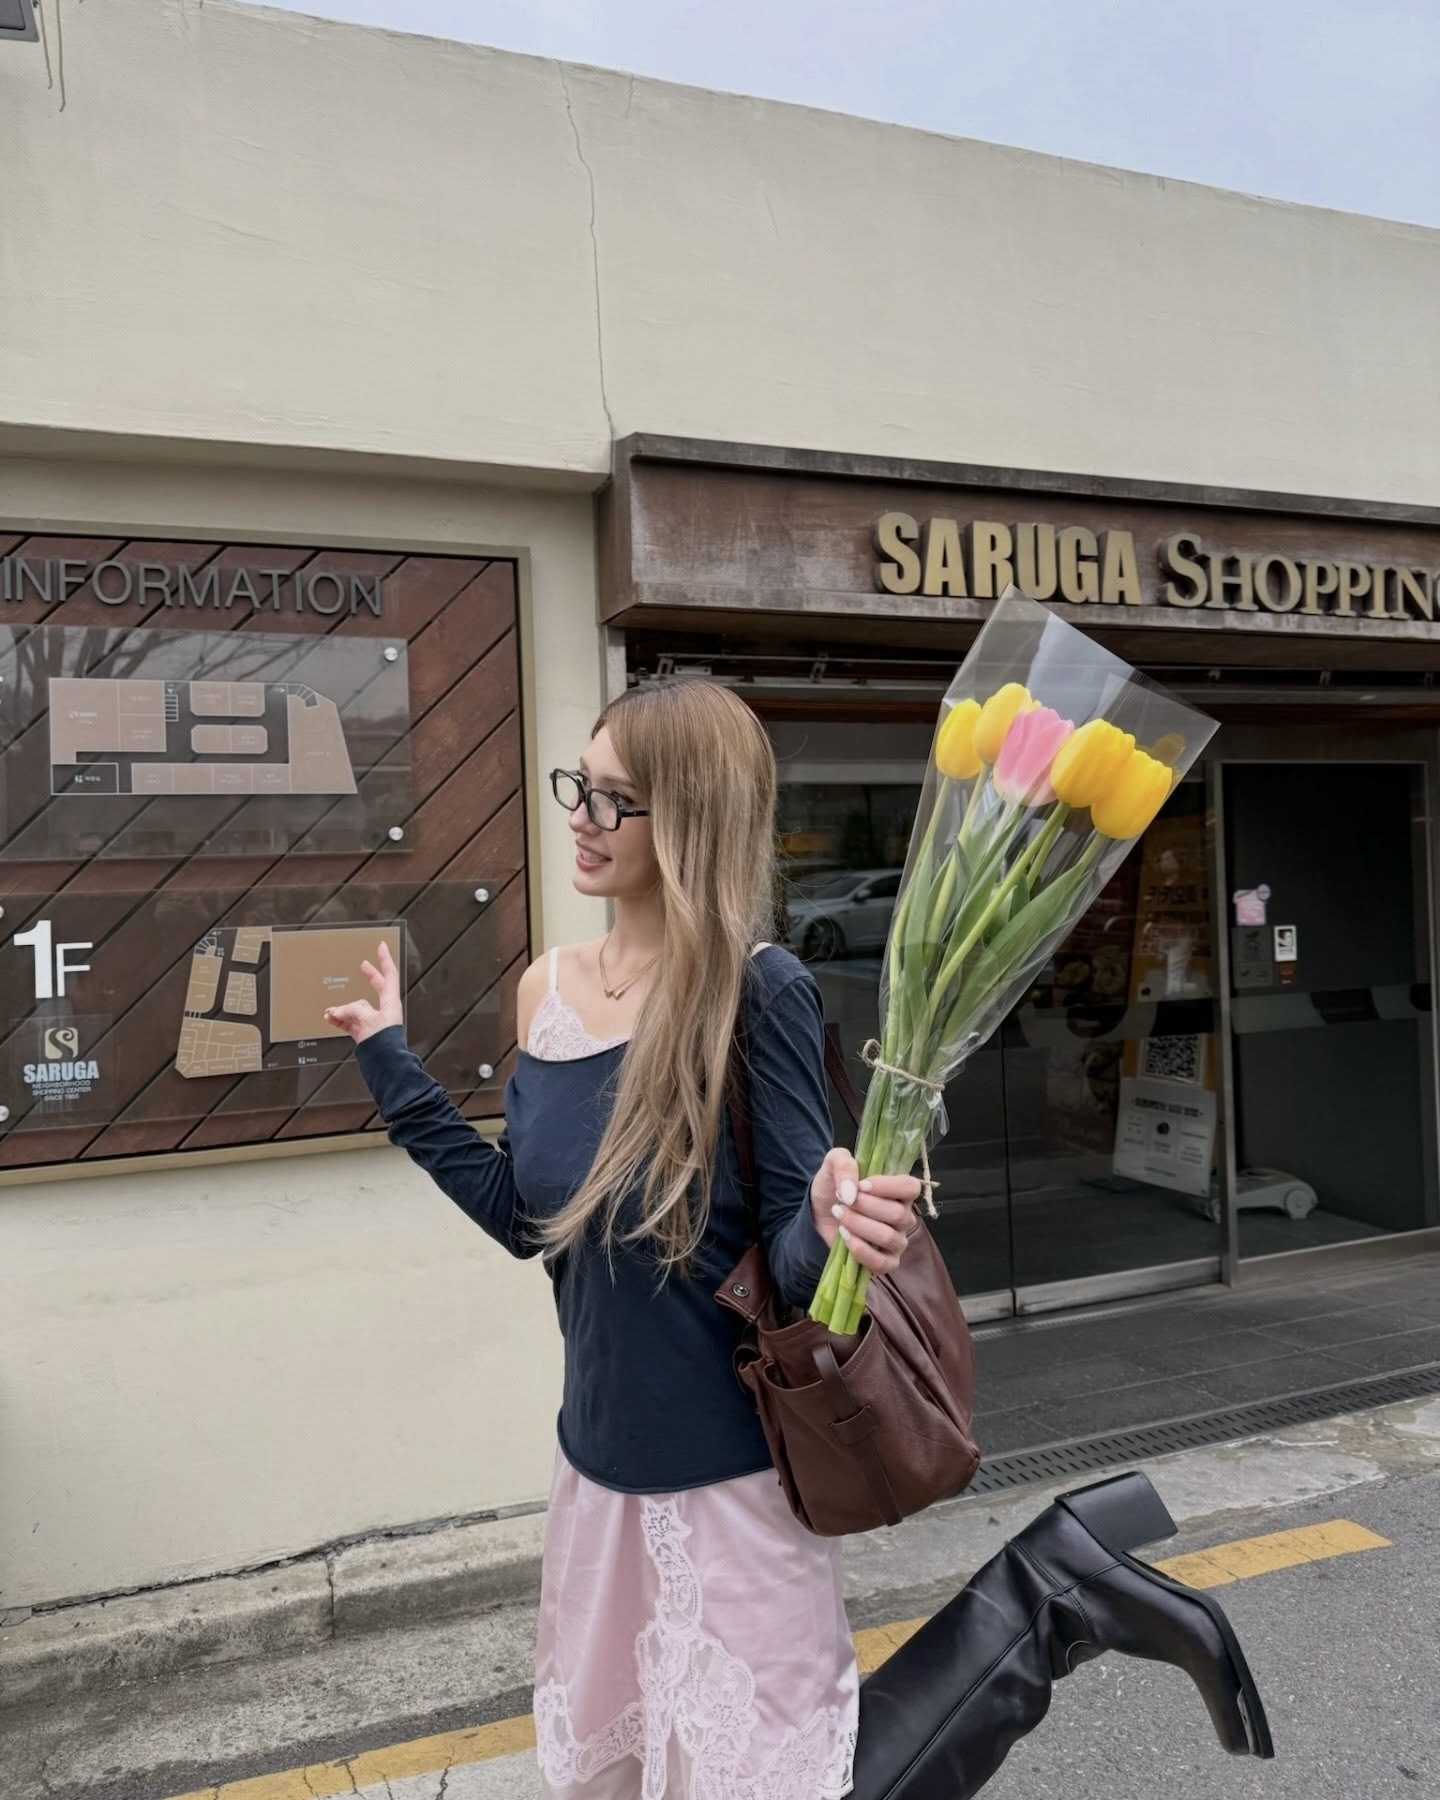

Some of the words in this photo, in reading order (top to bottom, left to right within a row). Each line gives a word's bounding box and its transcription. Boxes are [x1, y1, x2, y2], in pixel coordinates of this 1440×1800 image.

[3, 555, 383, 616] INFORMATION
[877, 511, 1142, 605] SARUGA
[1166, 532, 1440, 621] SHOPPIN
[13, 919, 93, 999] 1F
[23, 1060, 100, 1084] SARUGA
